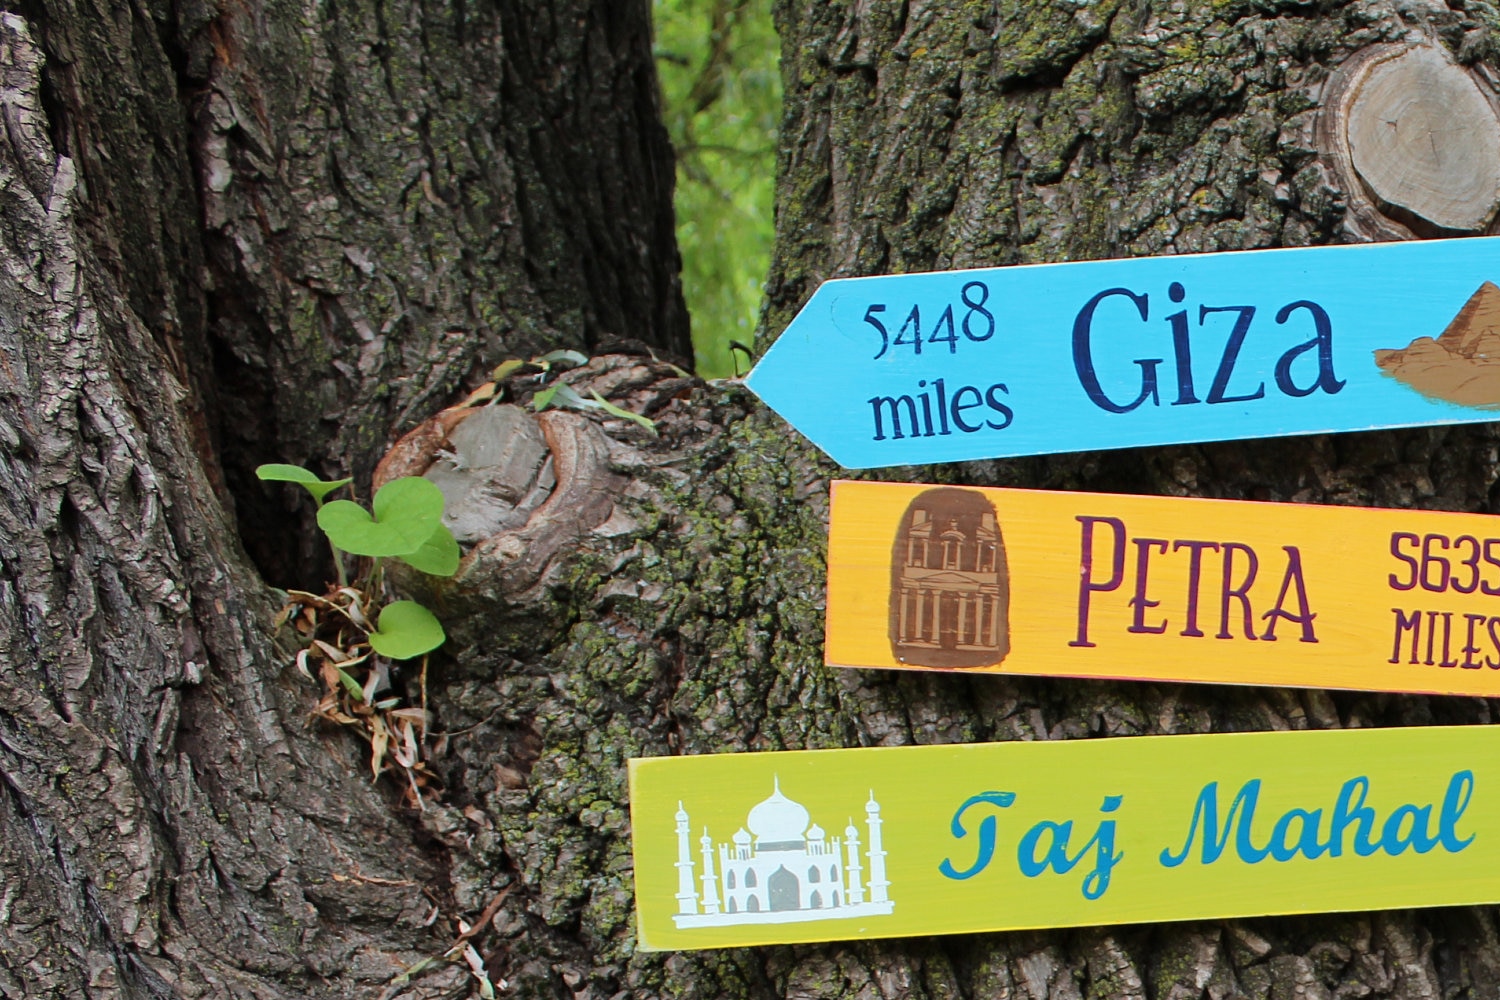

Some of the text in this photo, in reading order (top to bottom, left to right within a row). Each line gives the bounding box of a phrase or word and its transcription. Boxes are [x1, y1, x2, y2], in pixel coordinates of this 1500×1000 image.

[863, 280, 996, 360] 5448
[1071, 281, 1347, 414] Giza
[868, 378, 1014, 441] miles
[1068, 515, 1318, 648] PETRA
[938, 769, 1475, 901] Taj Mahal
